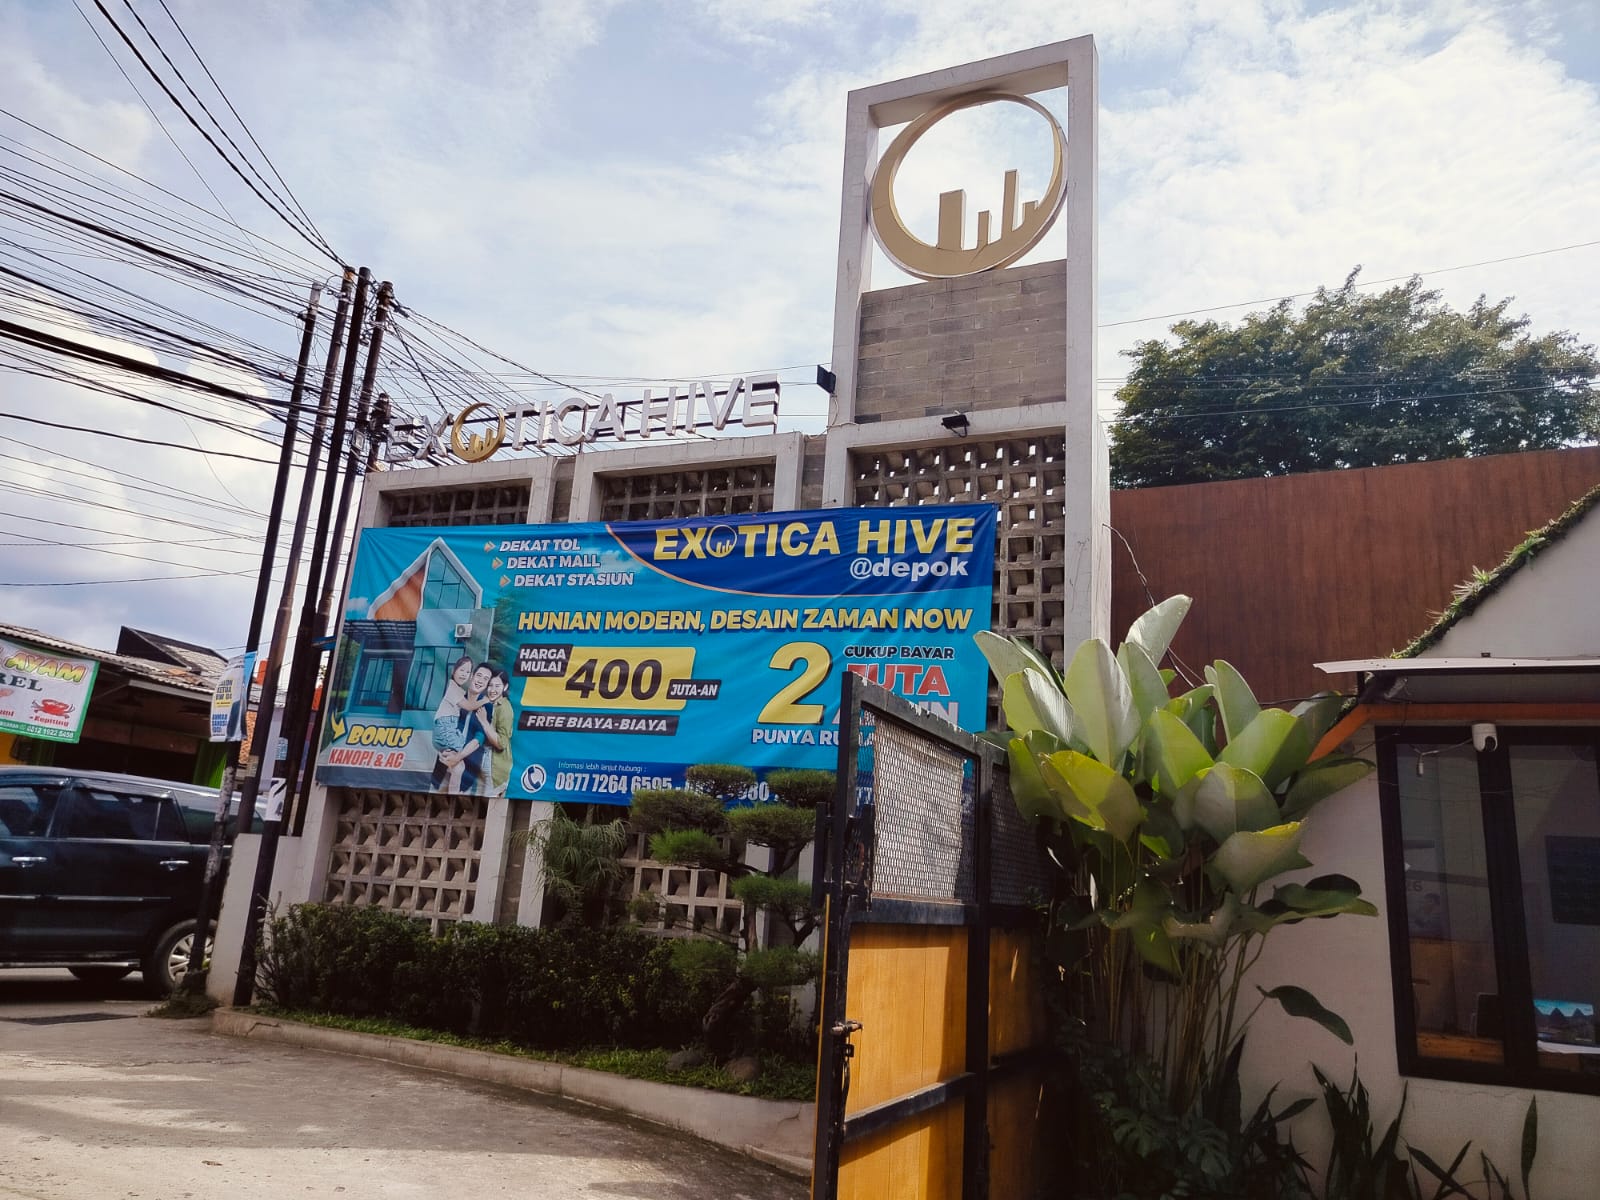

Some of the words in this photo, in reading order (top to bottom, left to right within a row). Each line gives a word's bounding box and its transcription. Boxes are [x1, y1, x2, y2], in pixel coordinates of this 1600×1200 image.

[640, 374, 779, 438] HIVE
[500, 539, 548, 551] DEKAT
[552, 538, 581, 550] TOL
[654, 522, 840, 560] EXOTICA
[857, 518, 975, 554] HIVE
[507, 556, 558, 569] DEKAT
[560, 554, 601, 568] MALL
[850, 557, 968, 582] @depok
[514, 574, 565, 587] DEKAT
[567, 572, 634, 586] STASIUN
[518, 612, 601, 630] HUNIAN
[603, 611, 705, 632] MODERN,
[710, 609, 799, 630] DESAIN
[803, 609, 899, 630] ZAMAN
[905, 609, 973, 629] NOW
[519, 648, 566, 661] HARGA
[844, 646, 897, 659] CUKUP
[901, 647, 954, 660] BAYAR
[5, 651, 87, 683] AYAM
[520, 660, 562, 673] MULAI
[565, 658, 662, 700] 400
[757, 641, 832, 725] 2
[670, 683, 718, 697] JUTA-AN
[527, 715, 566, 729] FREE
[567, 716, 667, 732] BIAYA-BIAYA
[346, 724, 413, 748] BONUS
[752, 729, 815, 745] PUNYA
[329, 748, 375, 766] KANOPI
[374, 753, 384, 767] &
[384, 752, 404, 768] AC
[558, 761, 585, 769] Informasi
[555, 772, 590, 791] 0877
[592, 774, 628, 794] 7264
